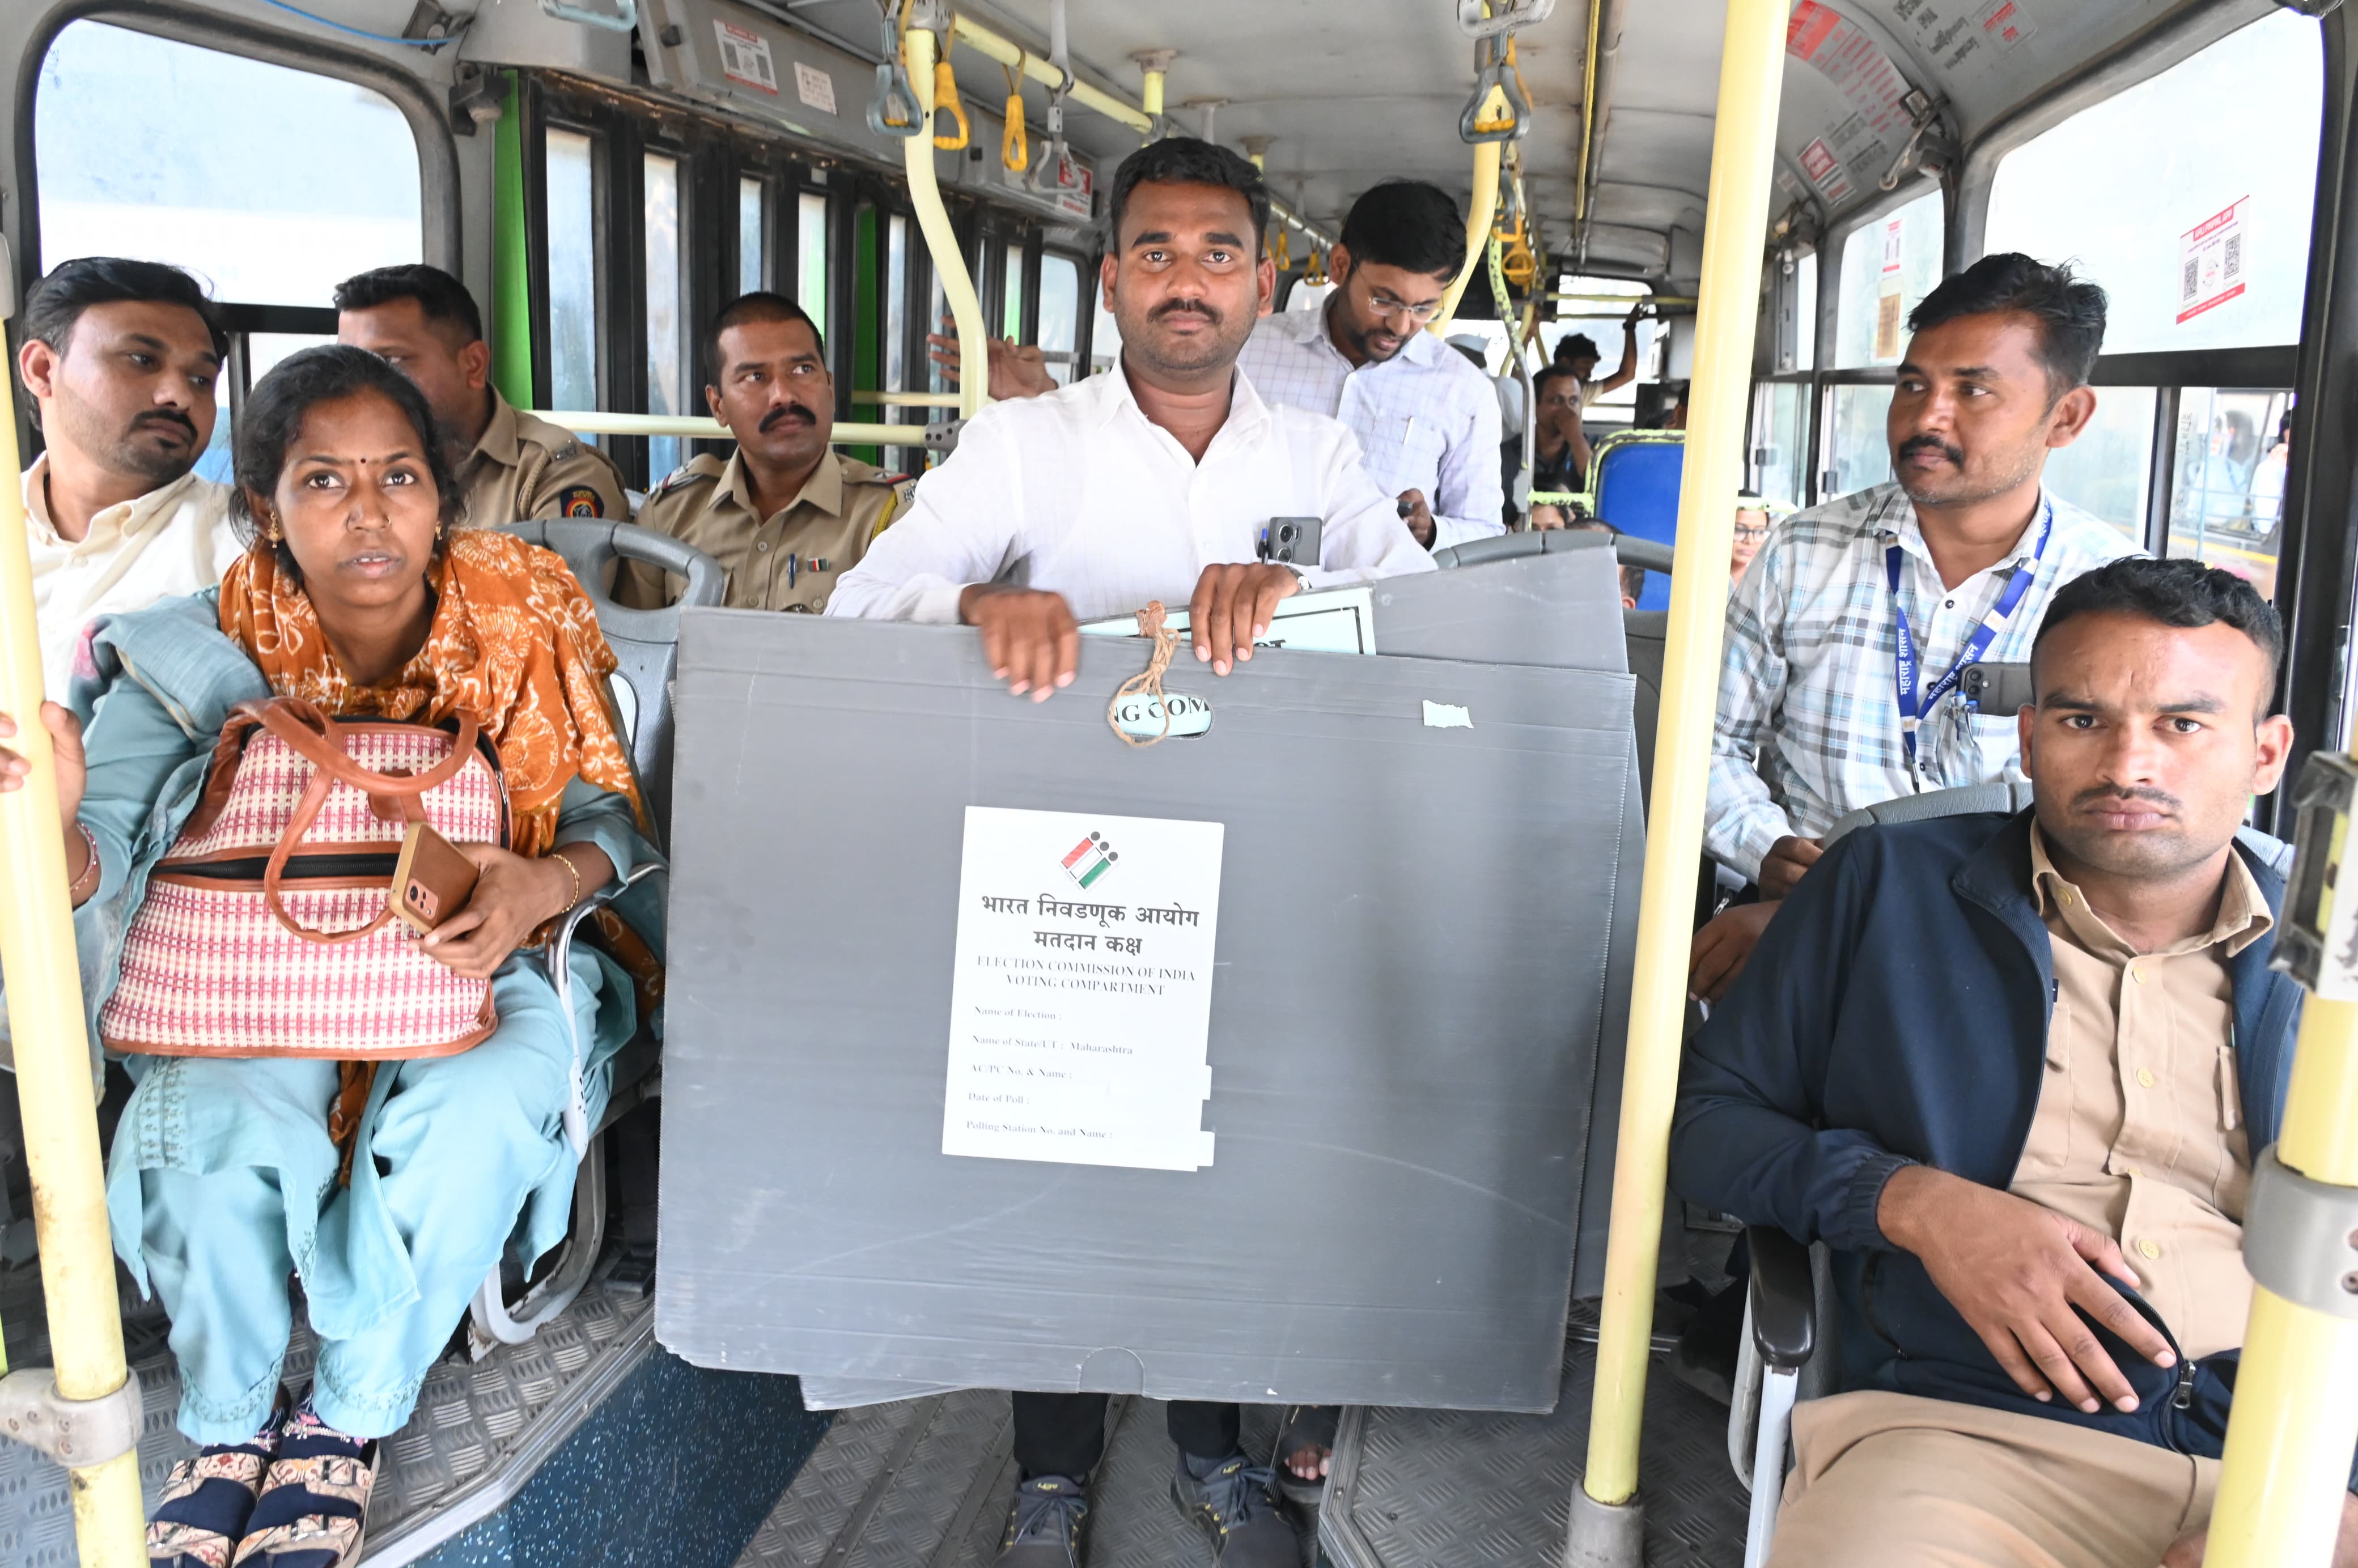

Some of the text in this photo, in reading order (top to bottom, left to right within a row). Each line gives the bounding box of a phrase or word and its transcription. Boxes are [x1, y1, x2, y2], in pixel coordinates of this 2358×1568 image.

[1898, 628, 1909, 657] शासन
[982, 893, 1199, 928] भारत निवडणूक आयोग
[1033, 931, 1143, 956] मतदान कक्ष
[978, 956, 1195, 981] ELECTION COMMISSION OF INDIA
[1007, 974, 1165, 996] VOTING COMPARTMENT
[974, 1006, 1002, 1016] Name
[1017, 1009, 1055, 1019] Election
[973, 1035, 1000, 1044] Name
[1070, 1042, 1133, 1055] Maharashtra
[1027, 1068, 1034, 1076] &
[1038, 1068, 1066, 1078] Name
[968, 1092, 990, 1102] Date
[1006, 1094, 1024, 1104] Poll
[966, 1120, 999, 1132] Polling
[1002, 1123, 1036, 1134] Station
[1079, 1128, 1107, 1138] Name
